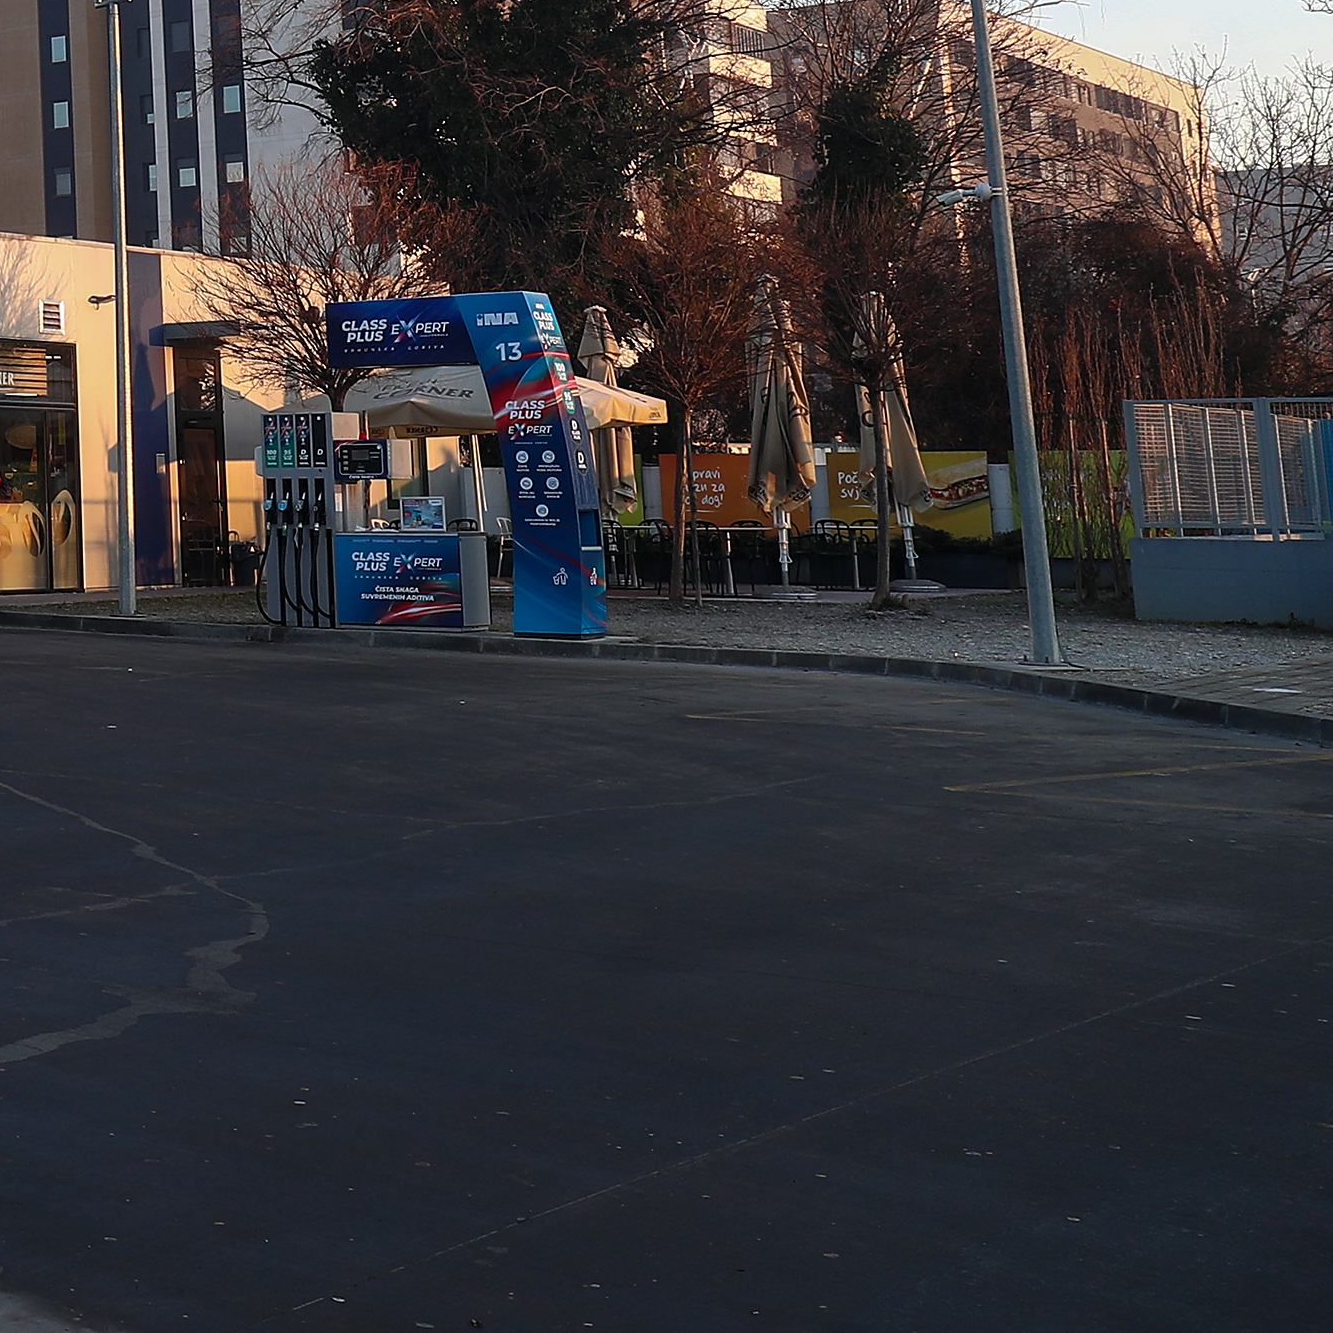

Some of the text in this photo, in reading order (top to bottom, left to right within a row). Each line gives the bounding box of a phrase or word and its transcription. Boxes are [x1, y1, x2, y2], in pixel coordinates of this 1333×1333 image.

[533, 311, 553, 321] CLASS
[341, 318, 387, 332] CLASS
[538, 321, 555, 330] PLUS
[346, 331, 384, 344] PLUS
[495, 341, 522, 361] 13
[505, 400, 545, 410] CLASS
[509, 410, 542, 419] PLUS
[577, 451, 585, 463] D
[712, 484, 726, 492] za
[702, 494, 724, 508] dog!
[352, 552, 390, 562] CLASS
[355, 562, 387, 571] PLUS
[375, 584, 394, 593] ČISTA
[406, 594, 434, 602] ADITIVA
